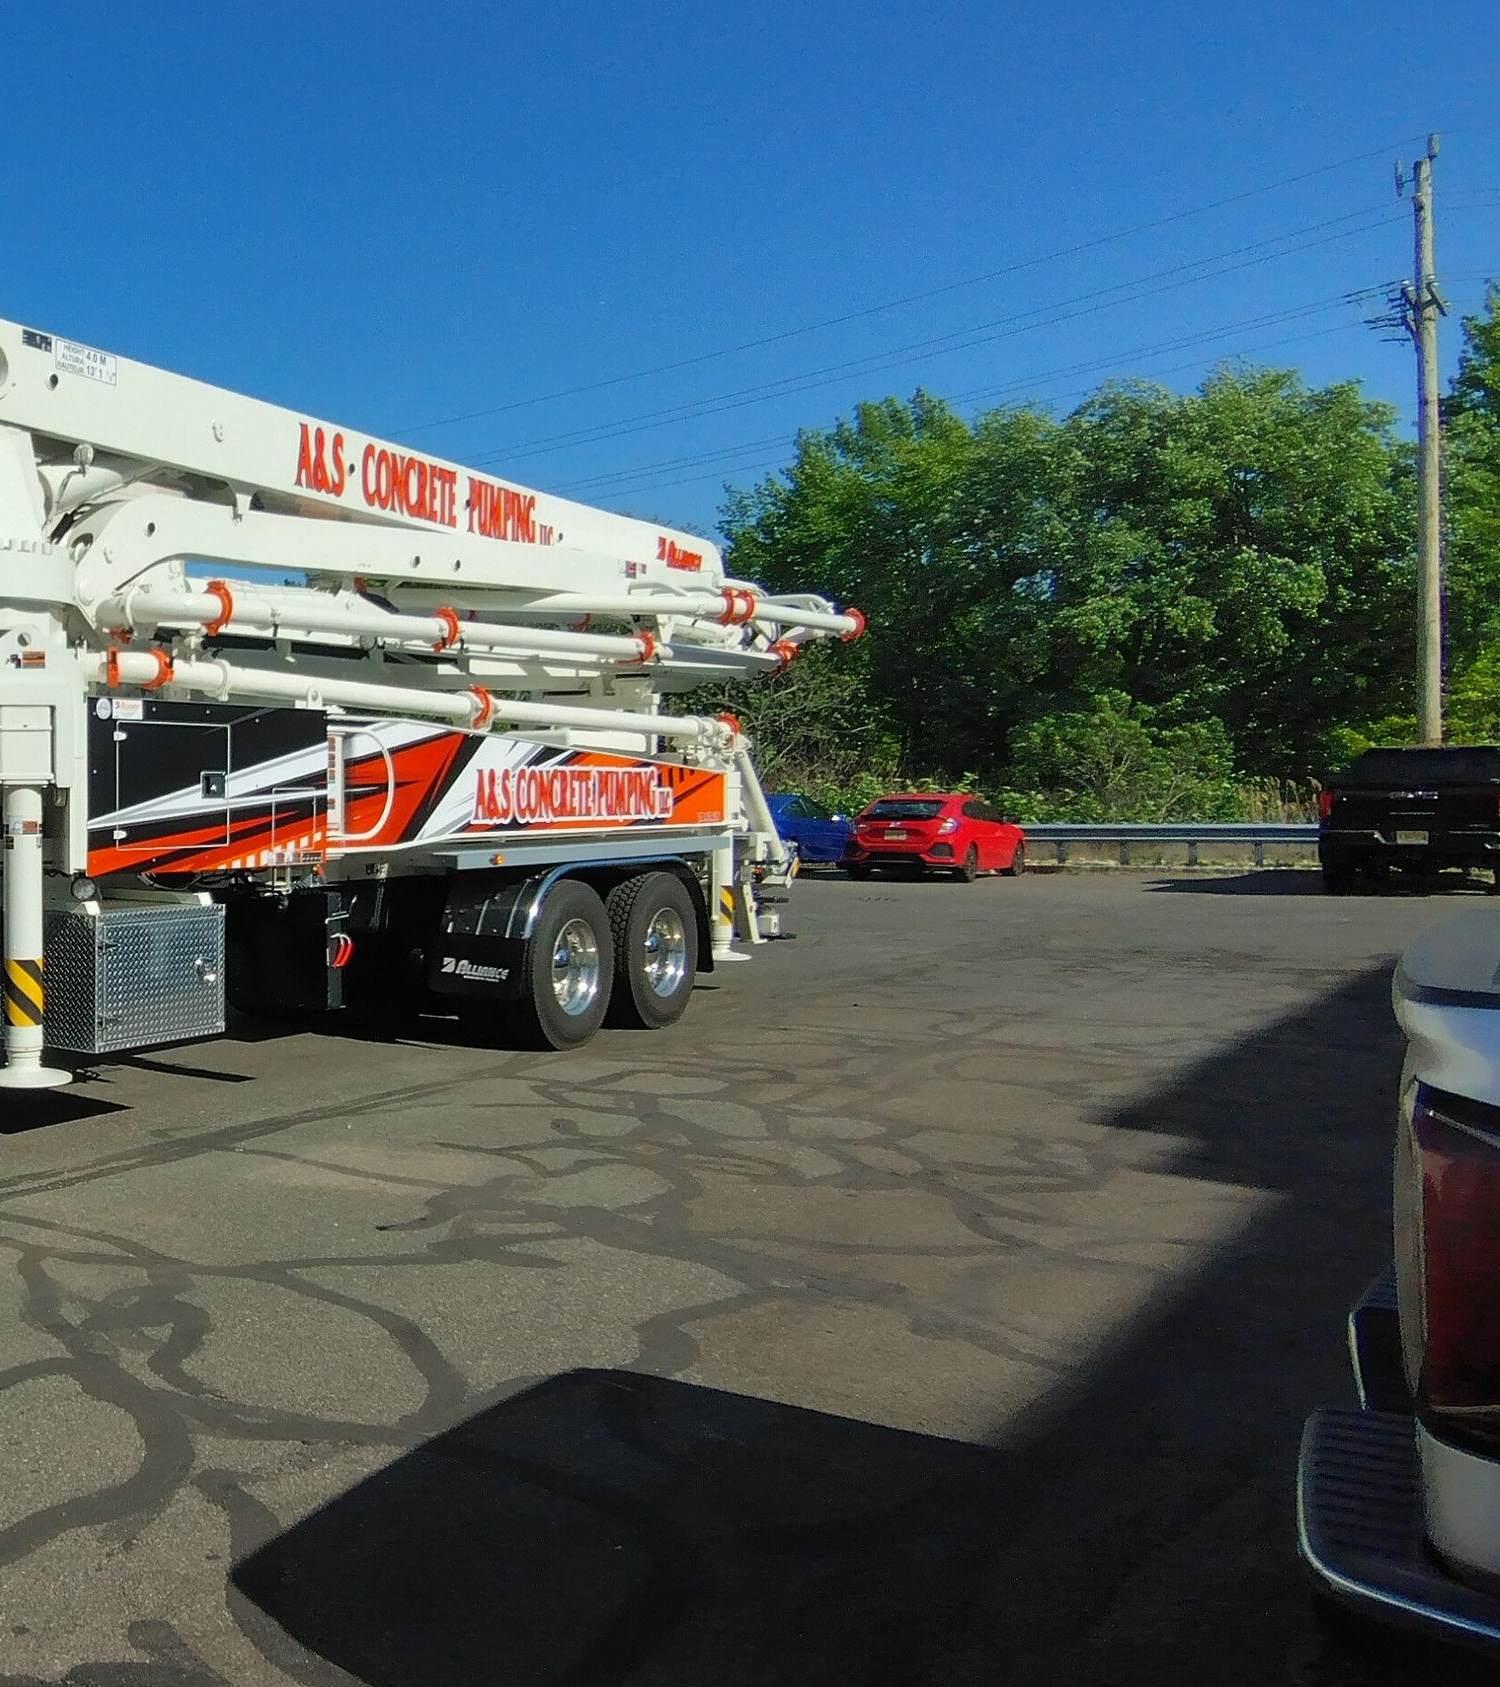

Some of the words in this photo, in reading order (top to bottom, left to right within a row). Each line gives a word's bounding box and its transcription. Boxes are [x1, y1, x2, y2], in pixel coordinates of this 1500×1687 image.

[294, 422, 345, 497] A&S
[362, 443, 457, 529] CONCRETE
[467, 476, 536, 544] PUMPING
[474, 768, 512, 820] A&S
[516, 768, 593, 819] CONCRETE
[595, 770, 657, 817] PUMPING
